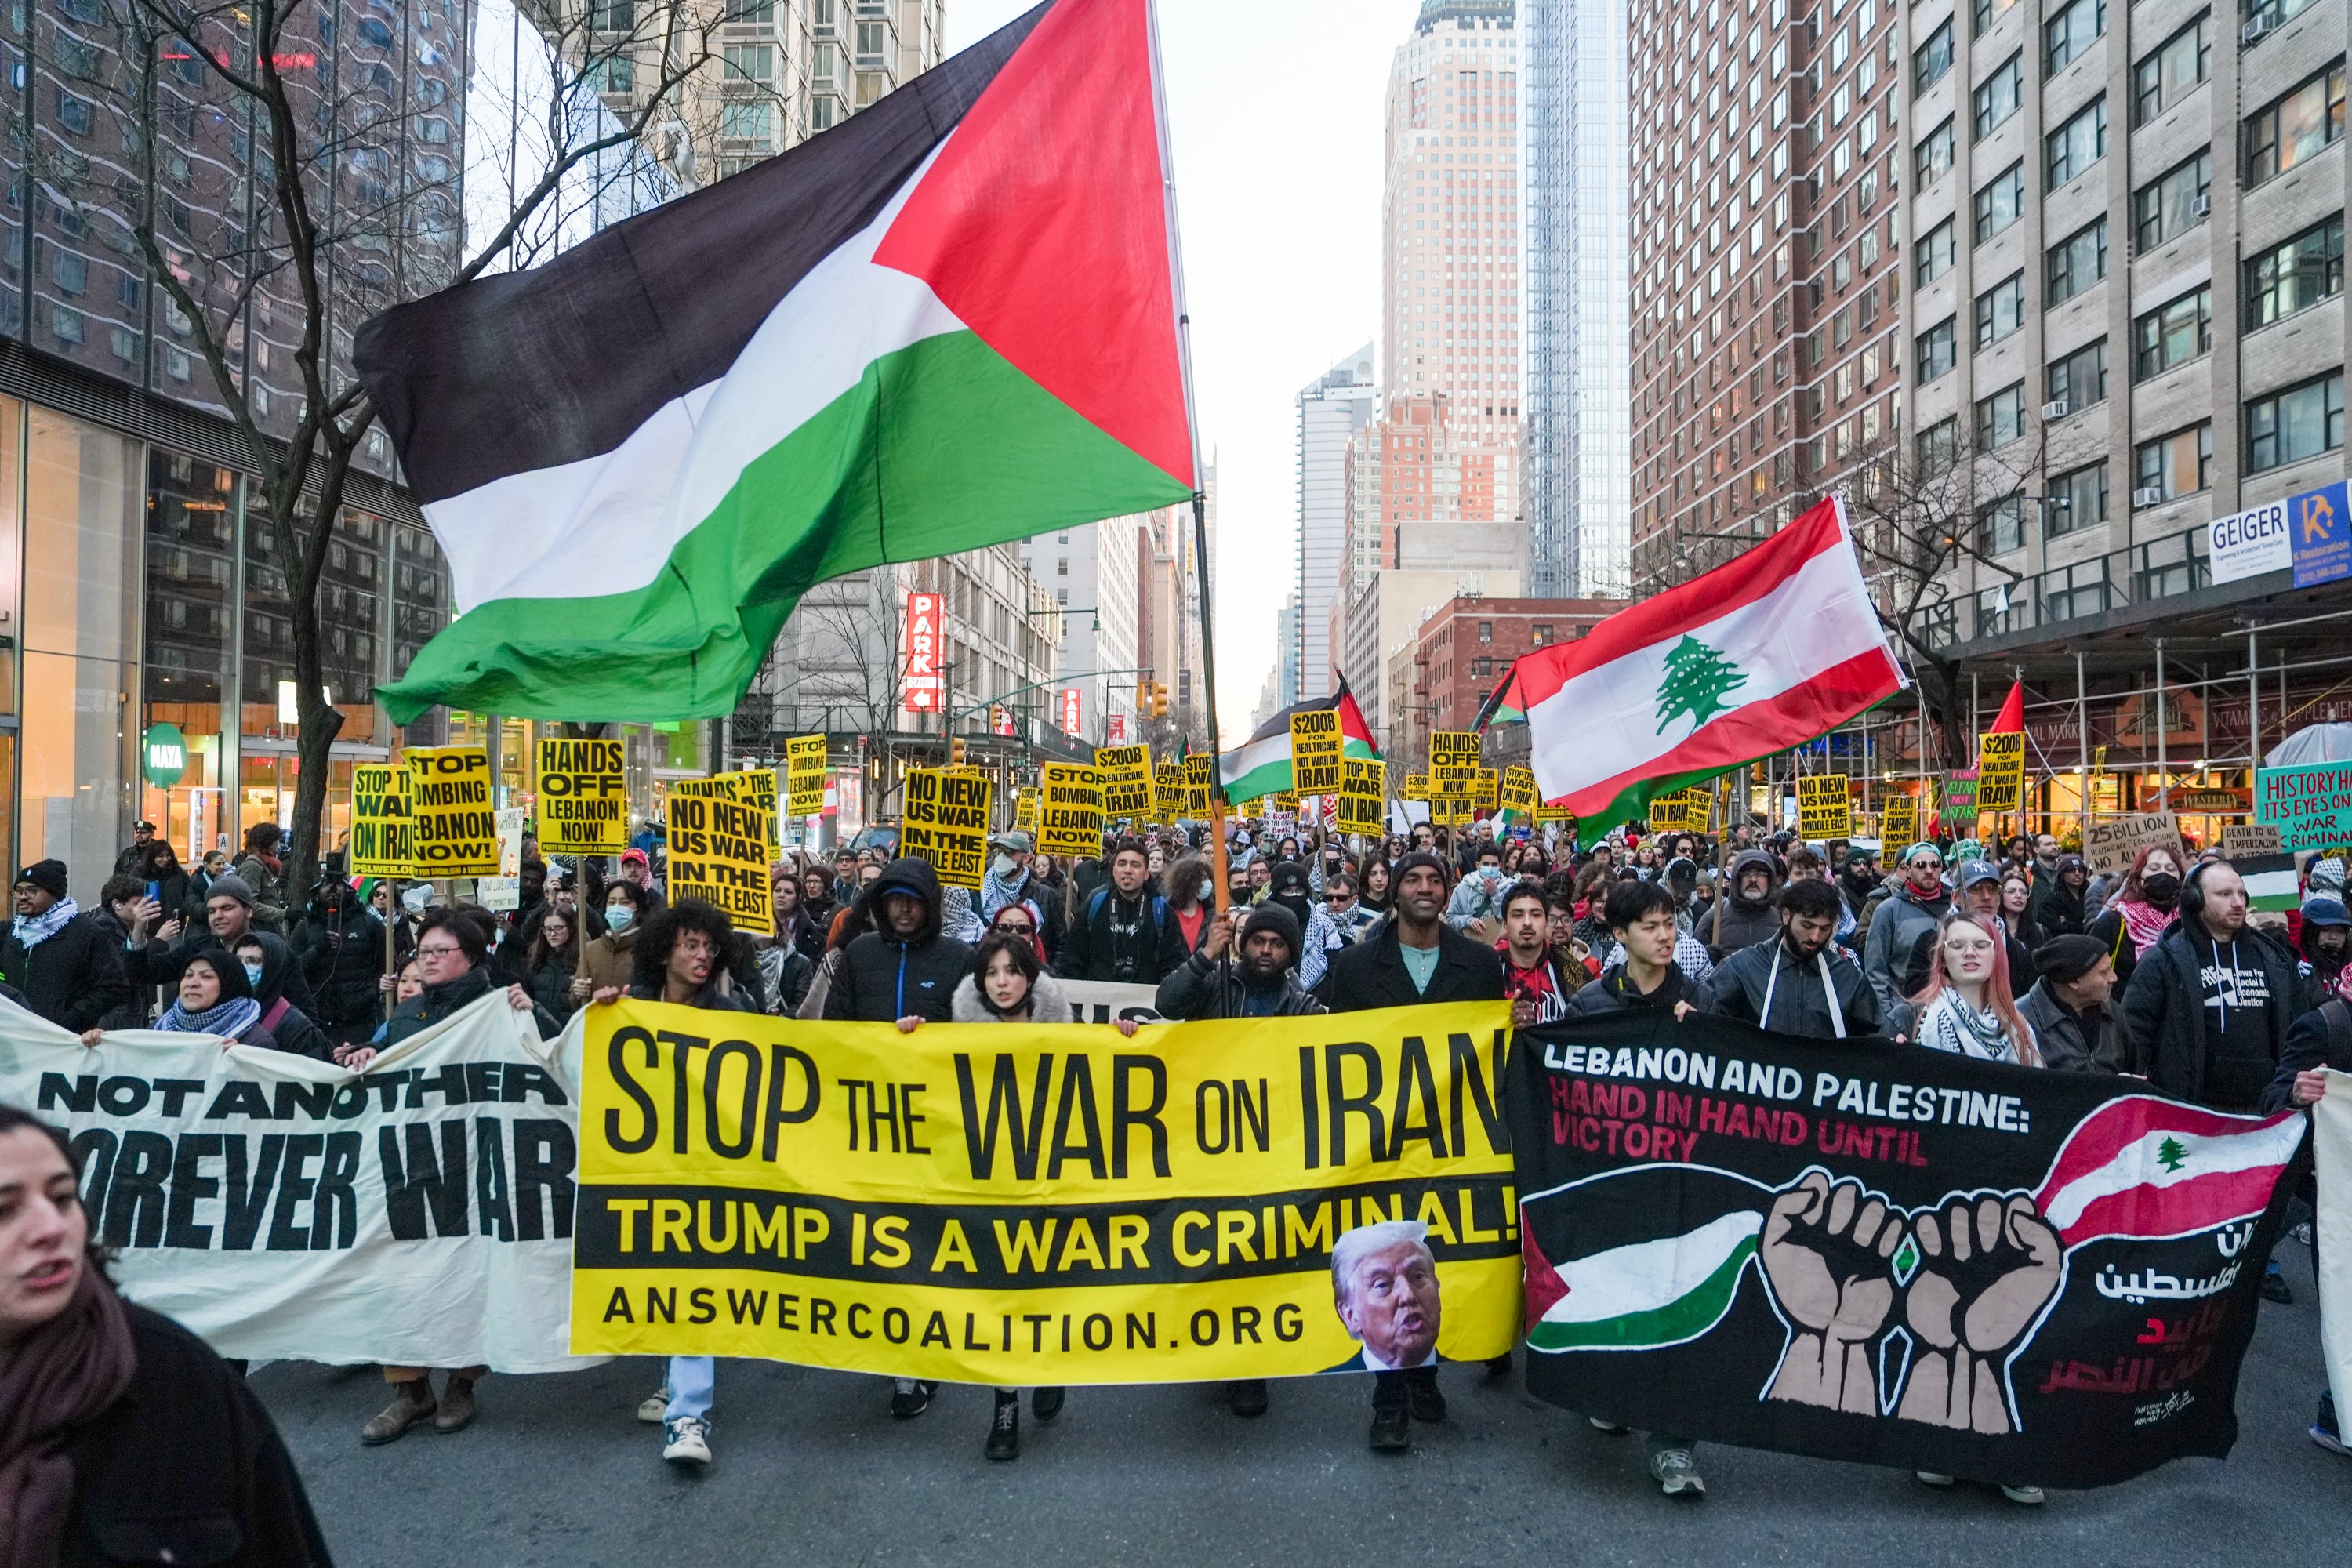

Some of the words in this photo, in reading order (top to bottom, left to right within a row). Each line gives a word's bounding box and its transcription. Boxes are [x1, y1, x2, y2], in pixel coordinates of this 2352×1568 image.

[2214, 506, 2284, 550] GEIGER
[2301, 541, 2350, 561] Restoration
[913, 597, 933, 673] PARK
[1066, 690, 1076, 731] PARK
[1294, 713, 1336, 735] $200B
[790, 739, 826, 754] STOP
[1296, 740, 1338, 754] HEALTHCARE
[1433, 734, 1479, 751] HANDS
[1985, 734, 2020, 755] $200B
[151, 744, 183, 768] NAYA
[409, 755, 487, 775] STOP
[543, 742, 622, 772] HANDS
[793, 755, 824, 771] BOMBING
[1099, 747, 1142, 768] $200B
[1297, 757, 1309, 768] NOT
[1312, 756, 1328, 767] WAR
[1330, 754, 1338, 765] ON
[1432, 753, 1479, 766] OFF
[1366, 763, 1382, 781] THE
[1435, 768, 1475, 780] LEBANON
[1507, 768, 1524, 779] STOP
[1952, 771, 1979, 779] FUND
[1983, 760, 2020, 772] HEALTHCARE
[356, 770, 391, 794] STOP
[541, 773, 623, 797] OFF
[749, 774, 772, 793] THE
[789, 774, 826, 793] LEBANON
[1048, 768, 1107, 785] STOP
[1107, 771, 1145, 783] EALTHCARE
[1156, 776, 1186, 786] OFF
[1298, 766, 1339, 789] IRAN!
[1506, 778, 1534, 790] WAR
[1799, 779, 1817, 795] NO
[1819, 776, 1845, 793] NEW
[1981, 775, 1993, 785] NOT
[1994, 775, 2009, 785] WAR
[2010, 774, 2018, 782] ON
[2267, 770, 2334, 800] HISTORY
[415, 780, 487, 807] OMBING
[909, 773, 937, 801] NO
[941, 777, 988, 808] NEW
[1120, 783, 1135, 793] WAR
[1137, 782, 1147, 791] ON
[1155, 785, 1185, 803] IRAN!
[1343, 779, 1381, 797] WAR
[1443, 781, 1467, 793] NOW!
[1979, 785, 2016, 804] IRAN!
[792, 793, 822, 806] NOW!
[1050, 786, 1103, 808] BOMBING
[1105, 793, 1149, 812] IRAN!
[1189, 788, 1207, 811] ON
[1277, 795, 1300, 804] WAR
[1502, 789, 1514, 800] ON
[1514, 790, 1533, 805] IRAN!
[1690, 791, 1697, 801] NO
[1697, 793, 1710, 804] NEW
[1800, 795, 1817, 807] US
[1818, 793, 1846, 806] WAR
[1888, 797, 1899, 809] WE
[1951, 796, 1970, 804] NOT
[547, 800, 619, 821] LEBANON
[907, 801, 935, 823] US
[938, 805, 985, 829] WAR
[1272, 811, 1294, 820] BOOTS
[1338, 797, 1356, 822] ON
[1356, 799, 1381, 825] IRAN!
[1435, 800, 1447, 815] ON
[1653, 804, 1667, 822] ON
[1696, 803, 1709, 812] WAR
[1801, 809, 1817, 819] IN
[1817, 808, 1847, 818] THE
[2265, 802, 2291, 821] ITS
[2295, 796, 2328, 816] EYES
[2332, 792, 2351, 809] ON
[414, 811, 495, 841] EBANON
[671, 798, 705, 831] NO
[713, 801, 762, 841] NEW
[1043, 808, 1104, 833] LEBANON
[1802, 819, 1830, 831] MIDDLE
[1831, 818, 1849, 830] EAST
[1886, 817, 1911, 831] EMPIRE!
[2293, 815, 2337, 833] WAR
[561, 822, 604, 842] NOW!
[1046, 830, 1100, 845] NOW!
[1338, 824, 1381, 835] PSLWEB.ORG
[1885, 833, 1911, 842] MONEY
[2088, 825, 2113, 845] 25
[2113, 815, 2168, 839] BILLION
[2227, 828, 2252, 838] DEATH
[2254, 827, 2264, 837] TO
[2267, 827, 2277, 836] US
[2281, 829, 2352, 848] CRIMINA
[220, 836, 227, 847] A
[354, 822, 376, 859] ON
[671, 831, 707, 855] US
[710, 834, 765, 866] WAR
[905, 827, 931, 846] IN
[934, 831, 983, 853] THE
[2133, 833, 2175, 848] EDUCATION?
[2230, 839, 2278, 850] IMPERIALISM
[414, 843, 492, 861] NOW!
[1883, 851, 1896, 862] NOT
[951, 851, 982, 873] EAST
[1973, 862, 1988, 873] NY
[2095, 858, 2111, 870] NO
[672, 861, 706, 882] IN
[710, 863, 767, 891] THE
[734, 889, 768, 916] EAST
[2253, 968, 2264, 978] For
[2259, 978, 2265, 987] &
[2238, 997, 2264, 1007] Justice
[38, 1072, 205, 1119] NOT
[205, 1062, 568, 1120] ANOTHER
[1544, 1044, 1715, 1091] LEBANON
[1721, 1059, 1802, 1101] AND
[1813, 1073, 2031, 1133] PALESTINE:
[604, 1025, 821, 1163] STOP
[838, 1078, 931, 1156] THE
[953, 1053, 1172, 1180] WAR
[1196, 1078, 1269, 1155] ON
[1298, 1028, 1513, 1170] IRAN
[1548, 1076, 1643, 1121] HAND
[1655, 1090, 1695, 1129] IN
[1699, 1097, 1809, 1148] HAND
[1817, 1119, 1929, 1168] UNTIL
[1552, 1110, 1700, 1164] VICTORY
[69, 1127, 363, 1250] OREVER
[379, 1117, 578, 1242] WAR
[607, 1198, 830, 1260] TRUMP
[851, 1212, 912, 1269] IS
[930, 1219, 978, 1272] A
[993, 1214, 1150, 1274] WAR
[1171, 1185, 1518, 1268] CRIMINAL!
[603, 1287, 1304, 1352] ANSWERCOALITION.ORG
